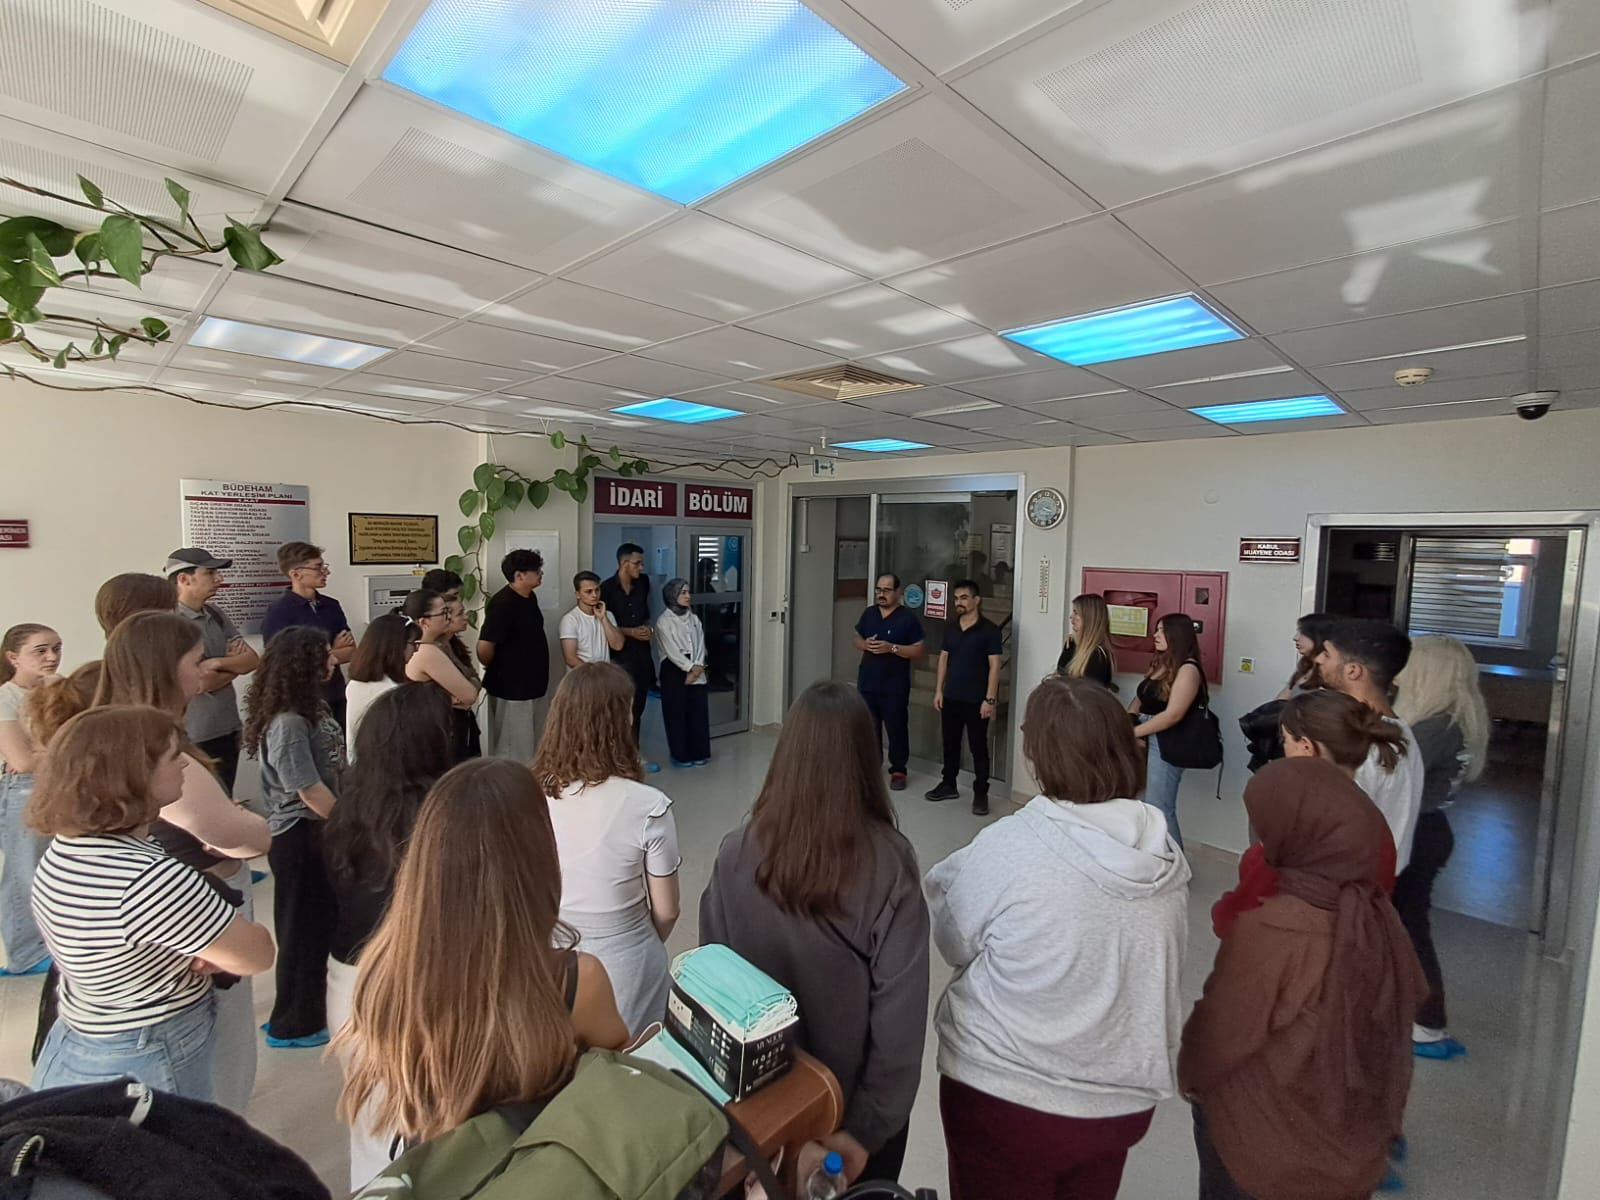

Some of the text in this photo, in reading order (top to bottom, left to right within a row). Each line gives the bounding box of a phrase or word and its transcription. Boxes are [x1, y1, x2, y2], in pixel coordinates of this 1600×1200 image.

[222, 483, 273, 492] BÜDEHAM
[609, 482, 748, 513] İDARİ BÖLÜM
